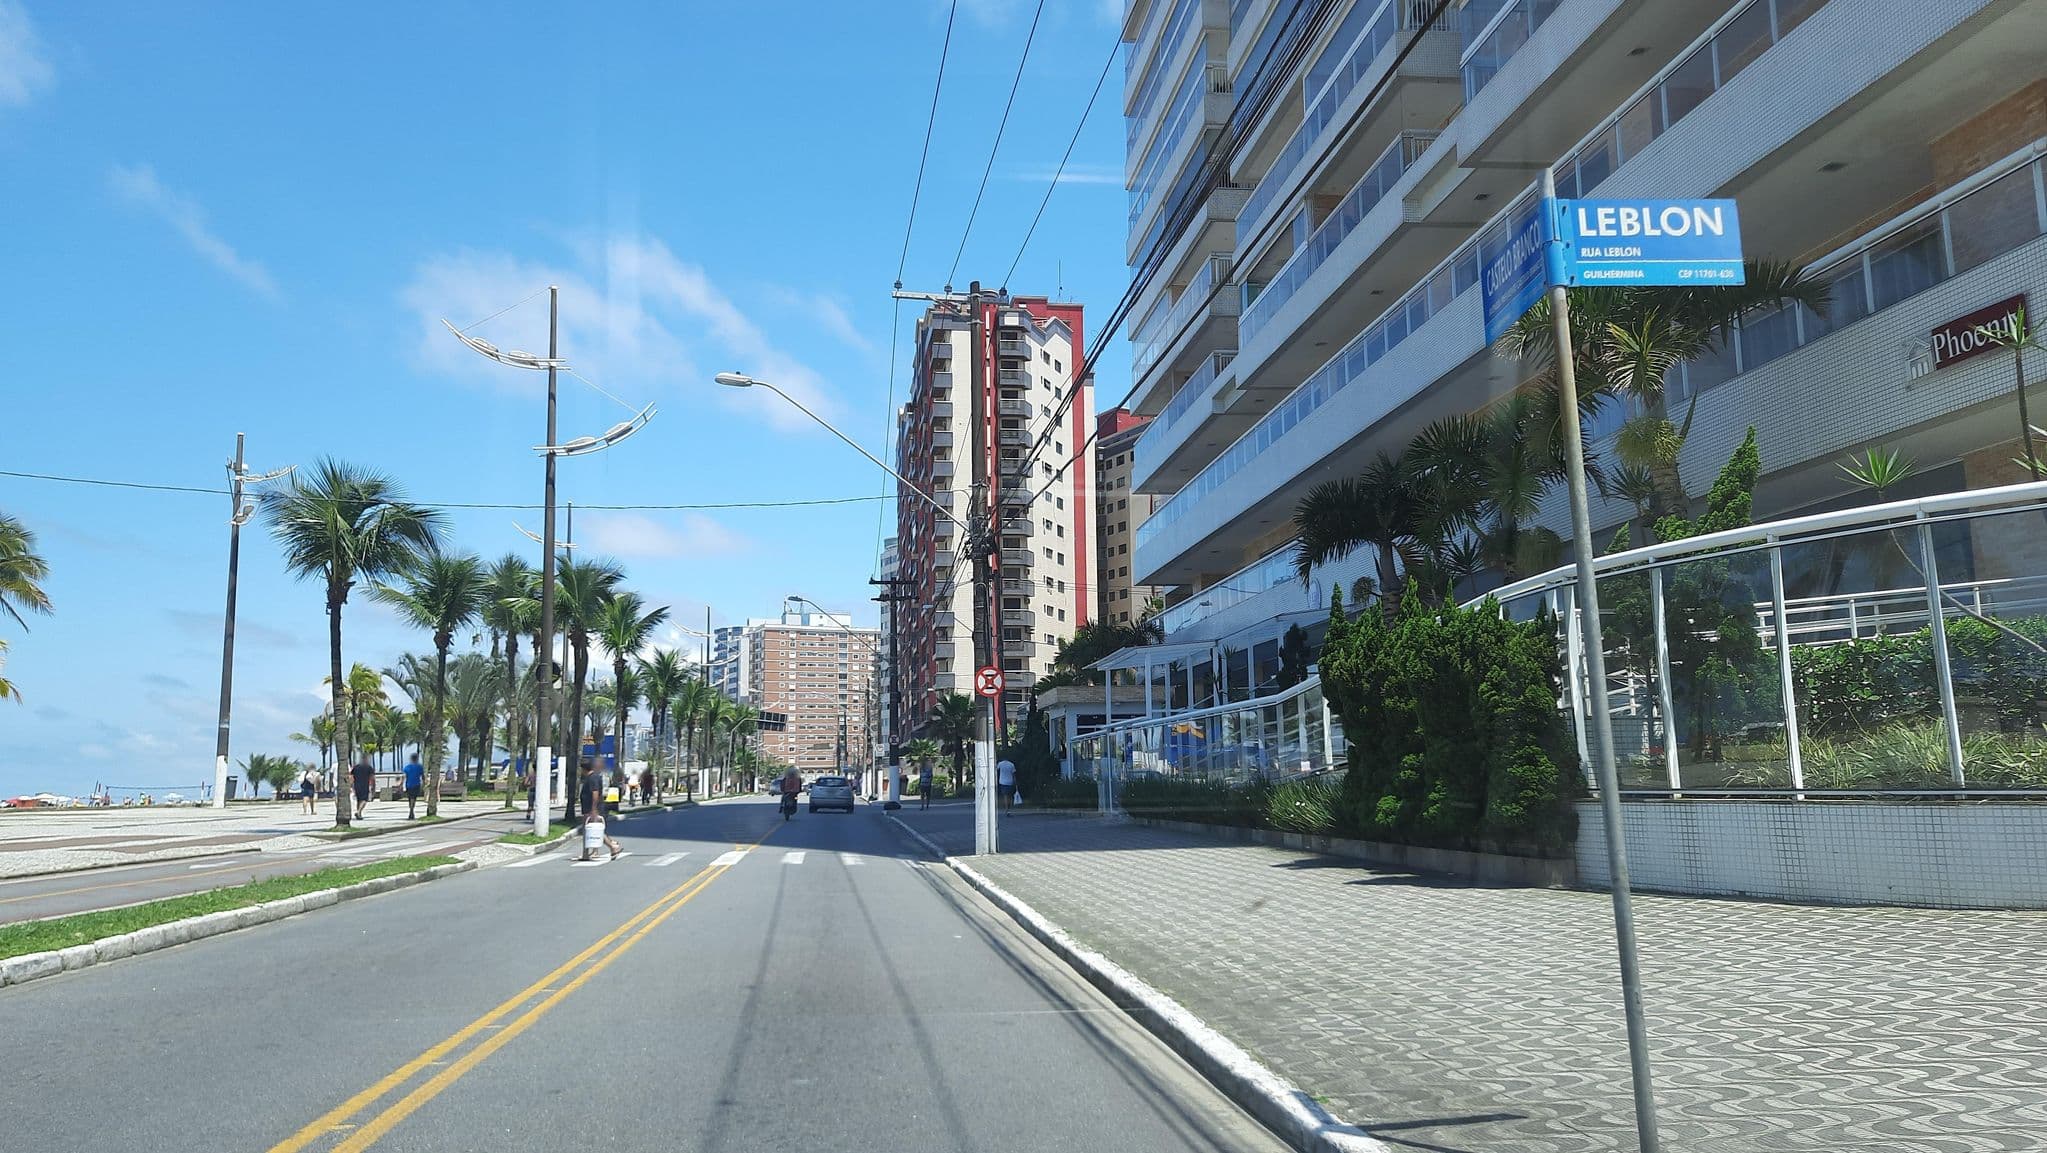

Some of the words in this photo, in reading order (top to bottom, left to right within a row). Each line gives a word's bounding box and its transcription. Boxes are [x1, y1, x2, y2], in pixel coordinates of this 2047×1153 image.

[1577, 206, 1724, 237] LEBLON
[1581, 247, 1602, 258] RUA
[1604, 246, 1642, 257] LEBLON
[1486, 249, 1512, 297] CASTELO
[1512, 220, 1541, 271] BRANCO
[1583, 269, 1645, 279] GUILHERMINA
[1678, 269, 1693, 279] CEP
